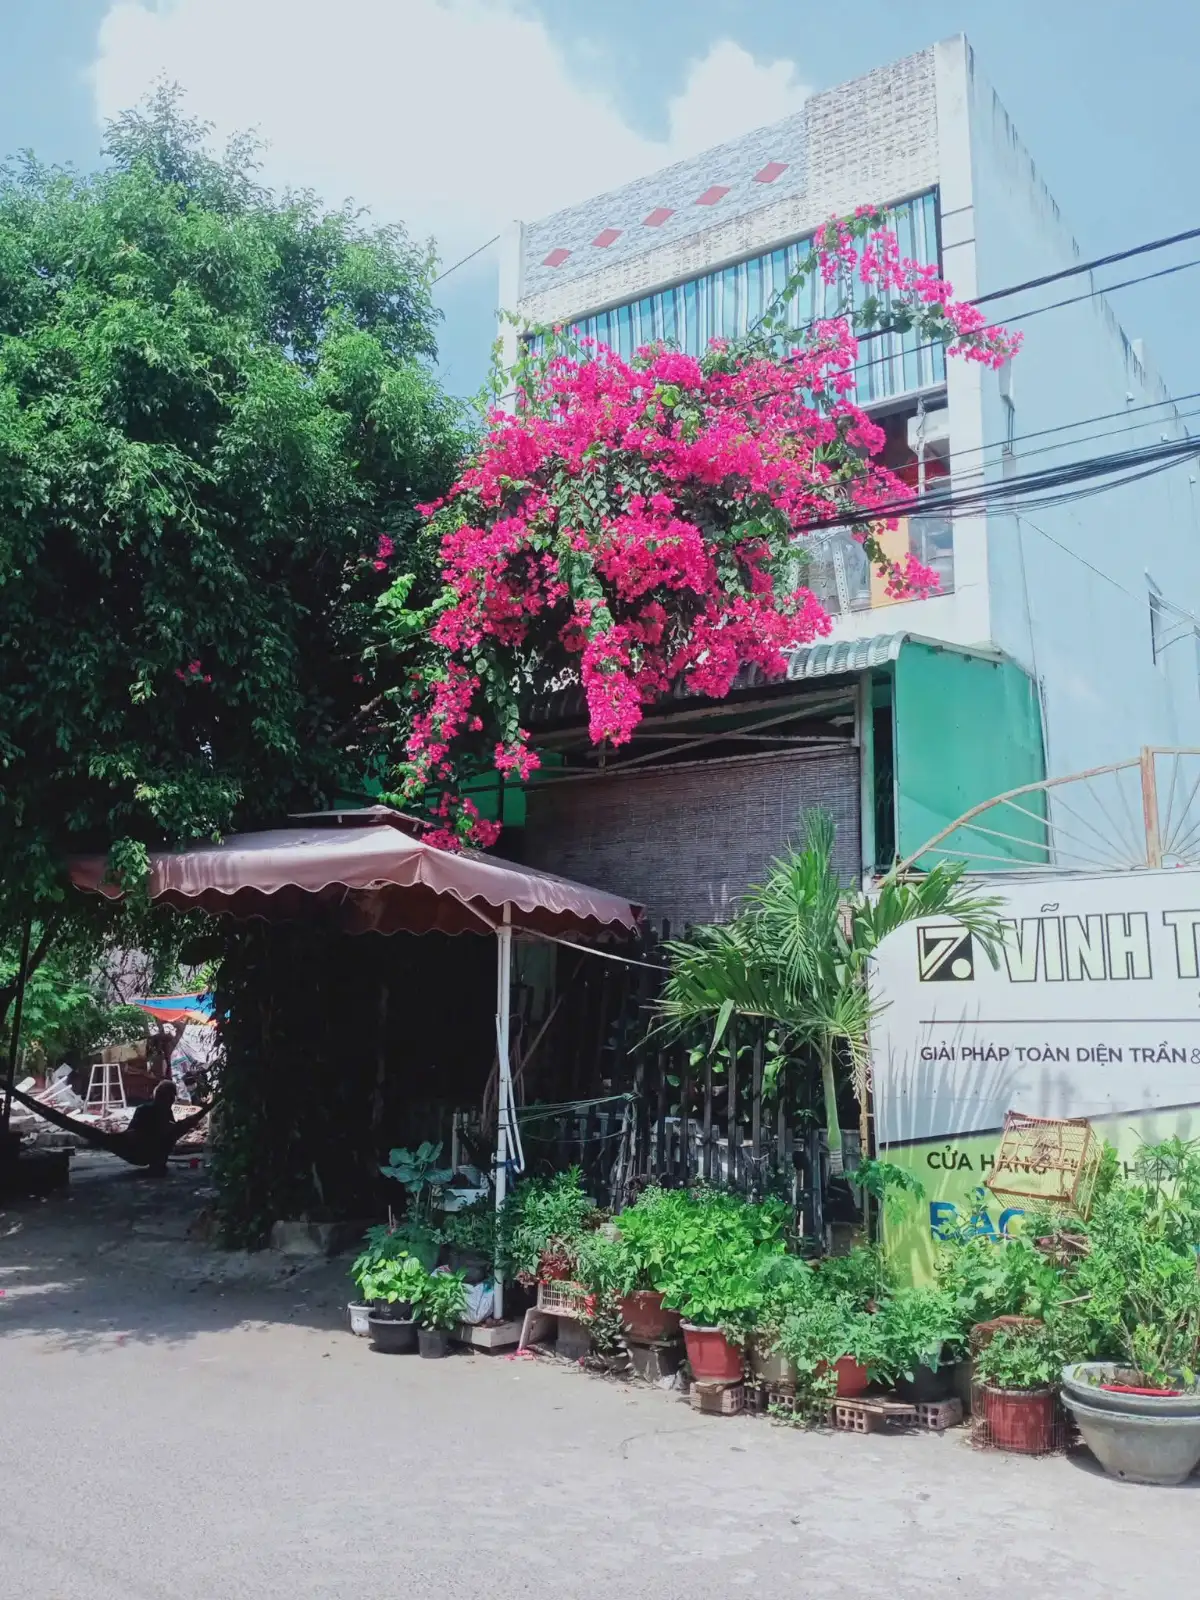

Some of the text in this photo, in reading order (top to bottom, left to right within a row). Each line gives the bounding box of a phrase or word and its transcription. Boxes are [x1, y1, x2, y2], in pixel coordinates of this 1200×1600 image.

[998, 903, 1153, 983] VĨNH
[920, 1041, 955, 1062] GIẢI
[961, 1042, 1010, 1062] PHÁP
[1015, 1043, 1070, 1063] TOÀN
[1077, 1043, 1123, 1067] DIỆN
[1129, 1040, 1187, 1064] TRẦN
[926, 1145, 974, 1171] CỬA
